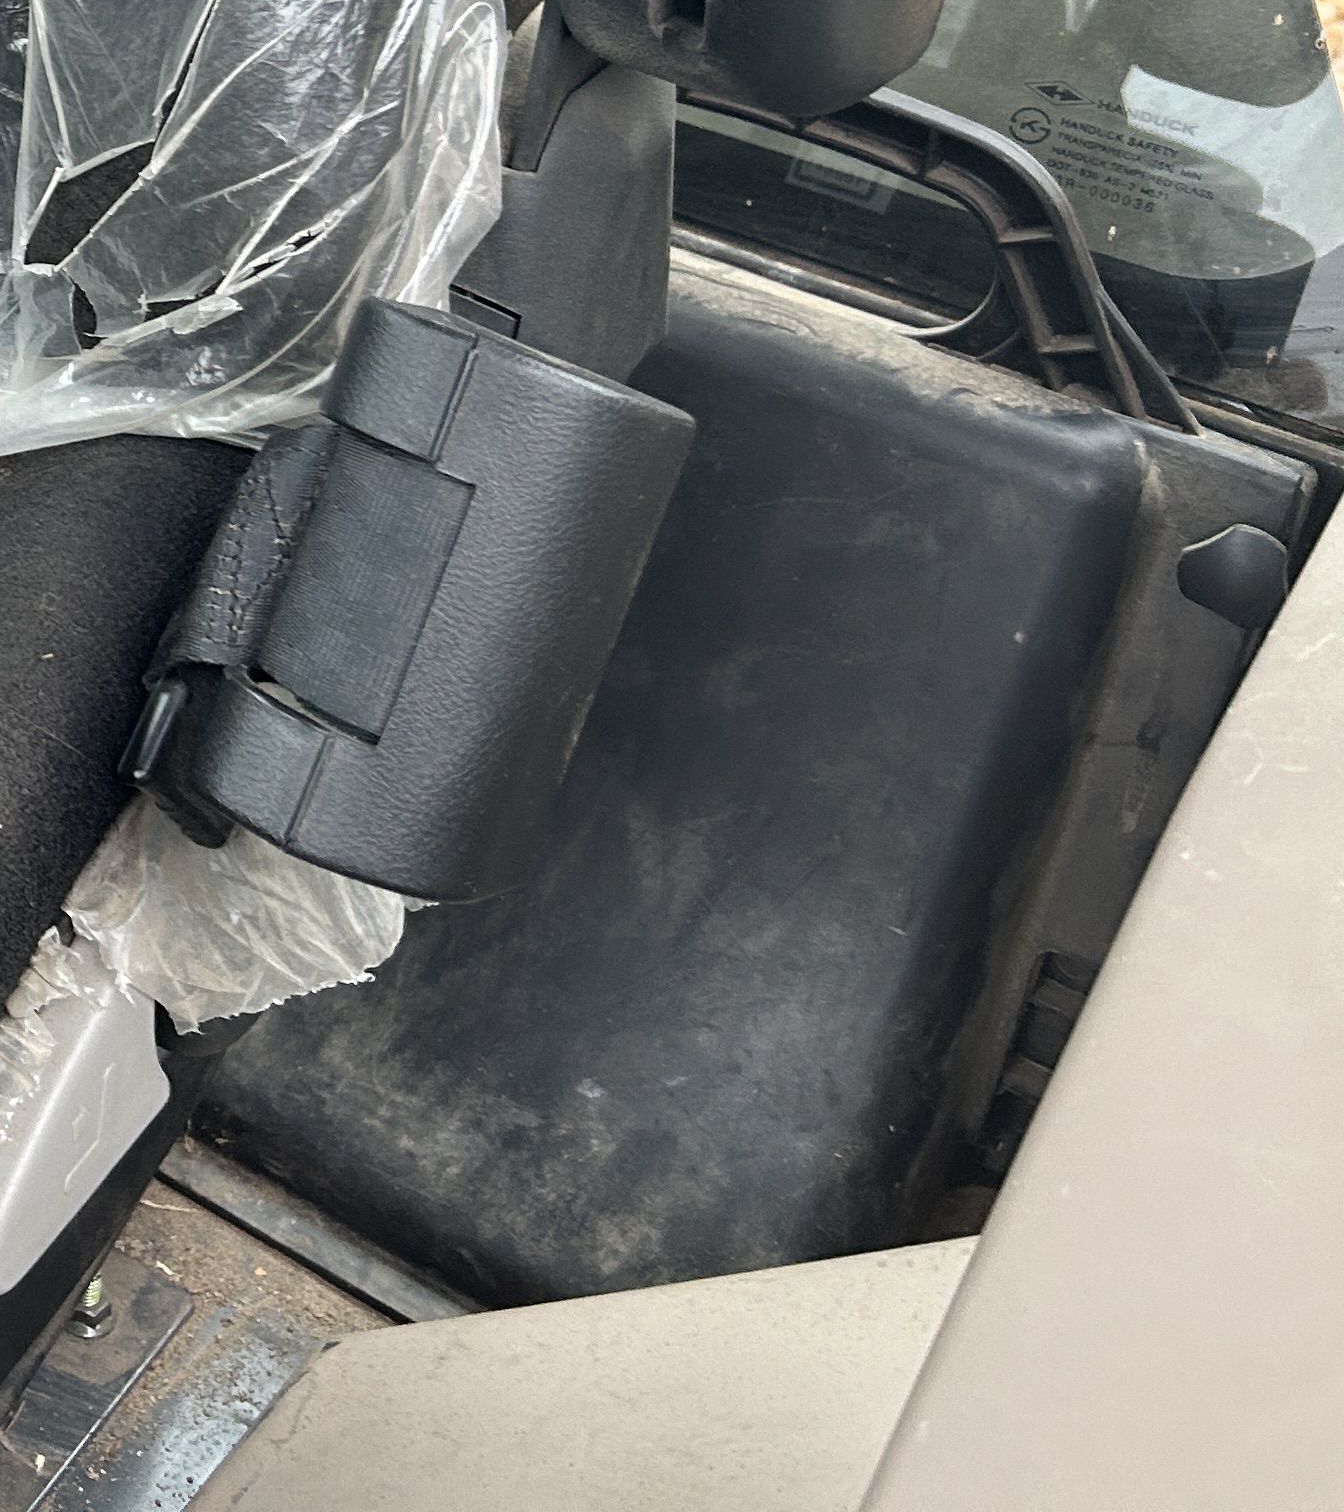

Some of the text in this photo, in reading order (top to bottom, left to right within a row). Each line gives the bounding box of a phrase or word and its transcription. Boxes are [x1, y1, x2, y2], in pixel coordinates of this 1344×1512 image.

[1098, 98, 1200, 136] HANDUCK
[1060, 117, 1180, 158] HANDUCK SAFETY
[1174, 182, 1214, 201] GLASS
